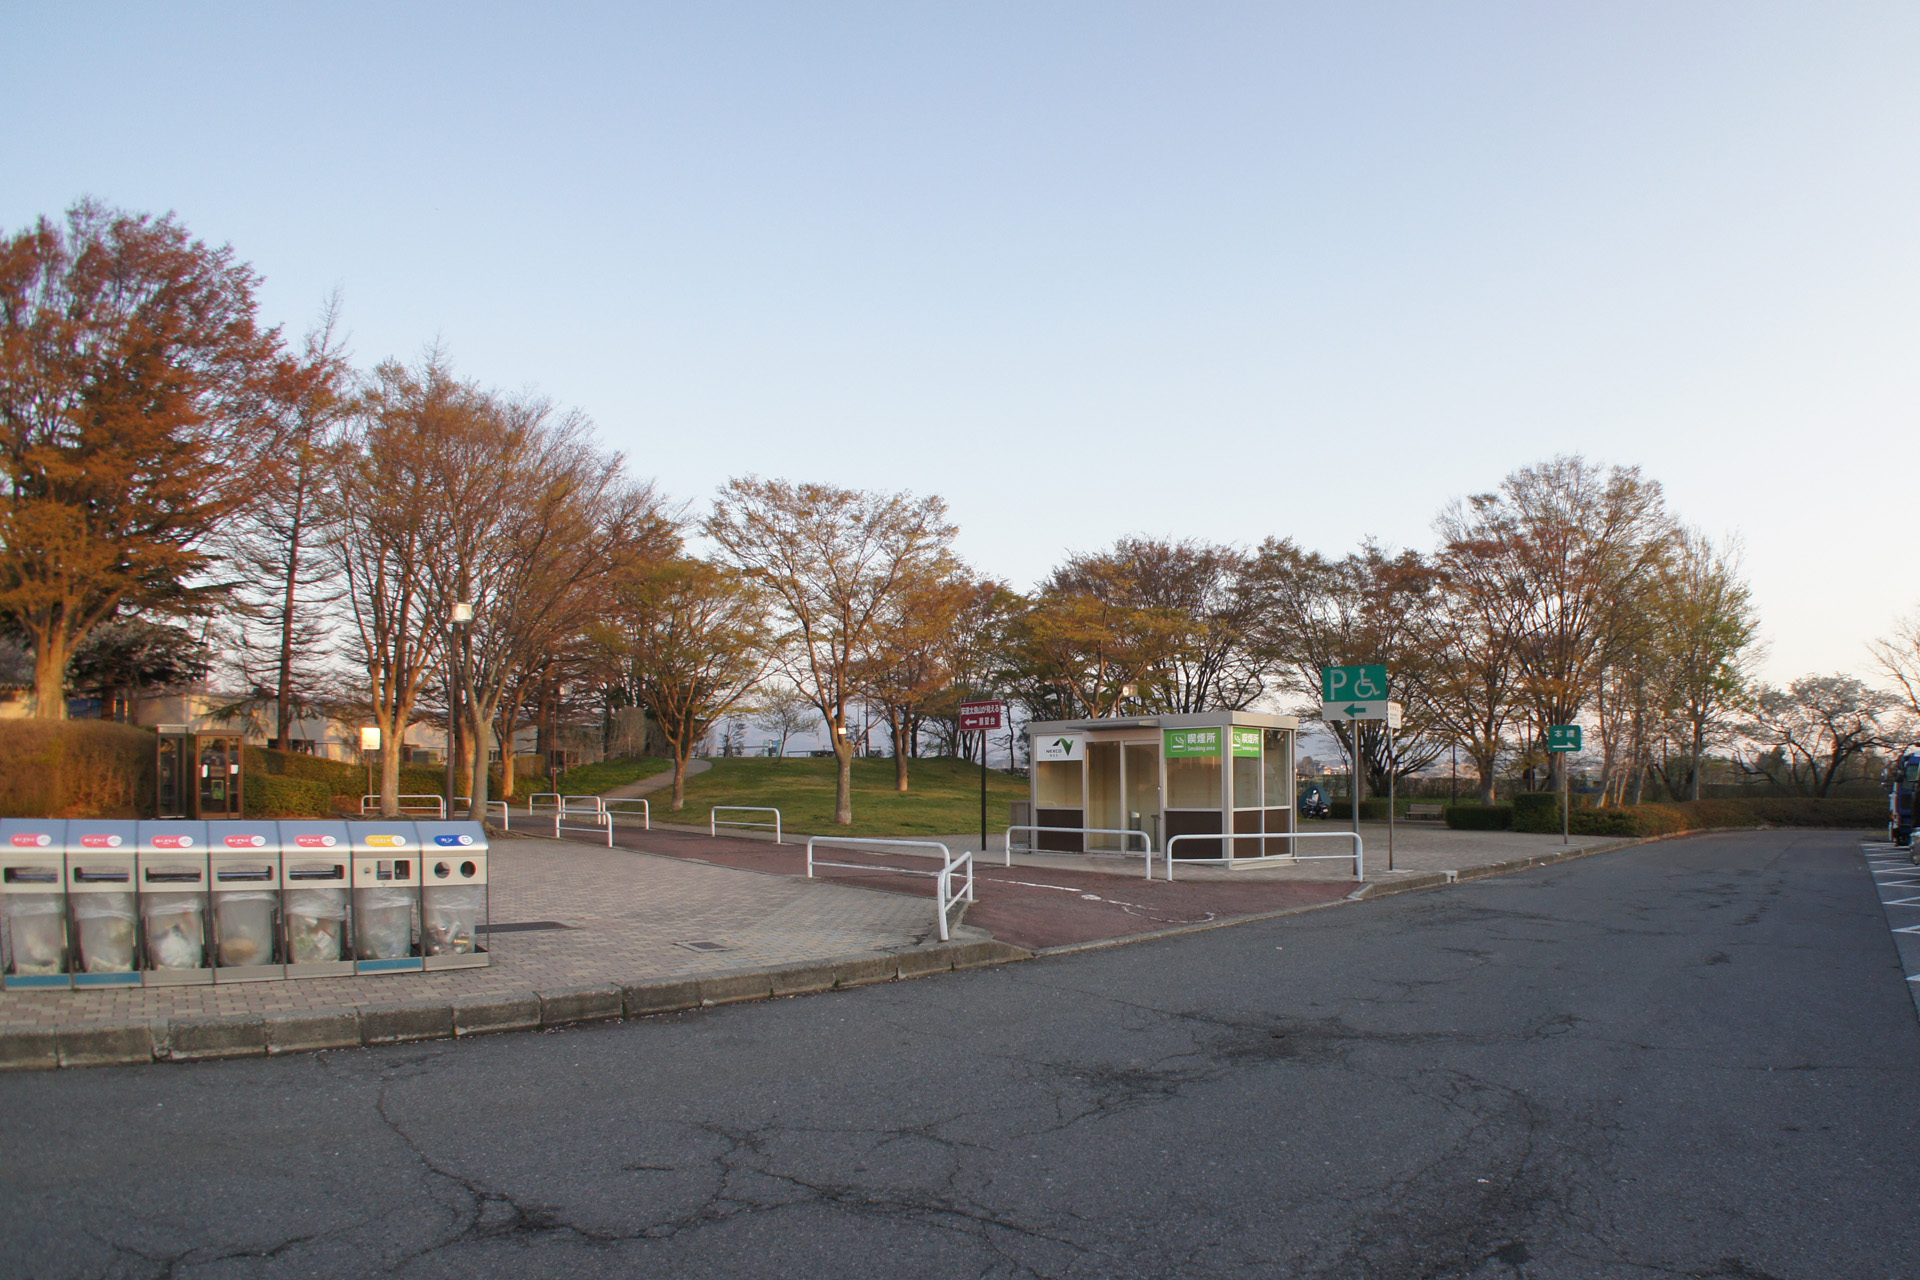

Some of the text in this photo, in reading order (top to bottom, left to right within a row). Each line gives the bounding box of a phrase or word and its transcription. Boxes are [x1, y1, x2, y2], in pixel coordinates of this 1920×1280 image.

[1330, 669, 1347, 700] P
[1187, 732, 1216, 744] 喫煙所
[1241, 733, 1259, 744] 喫煙所
